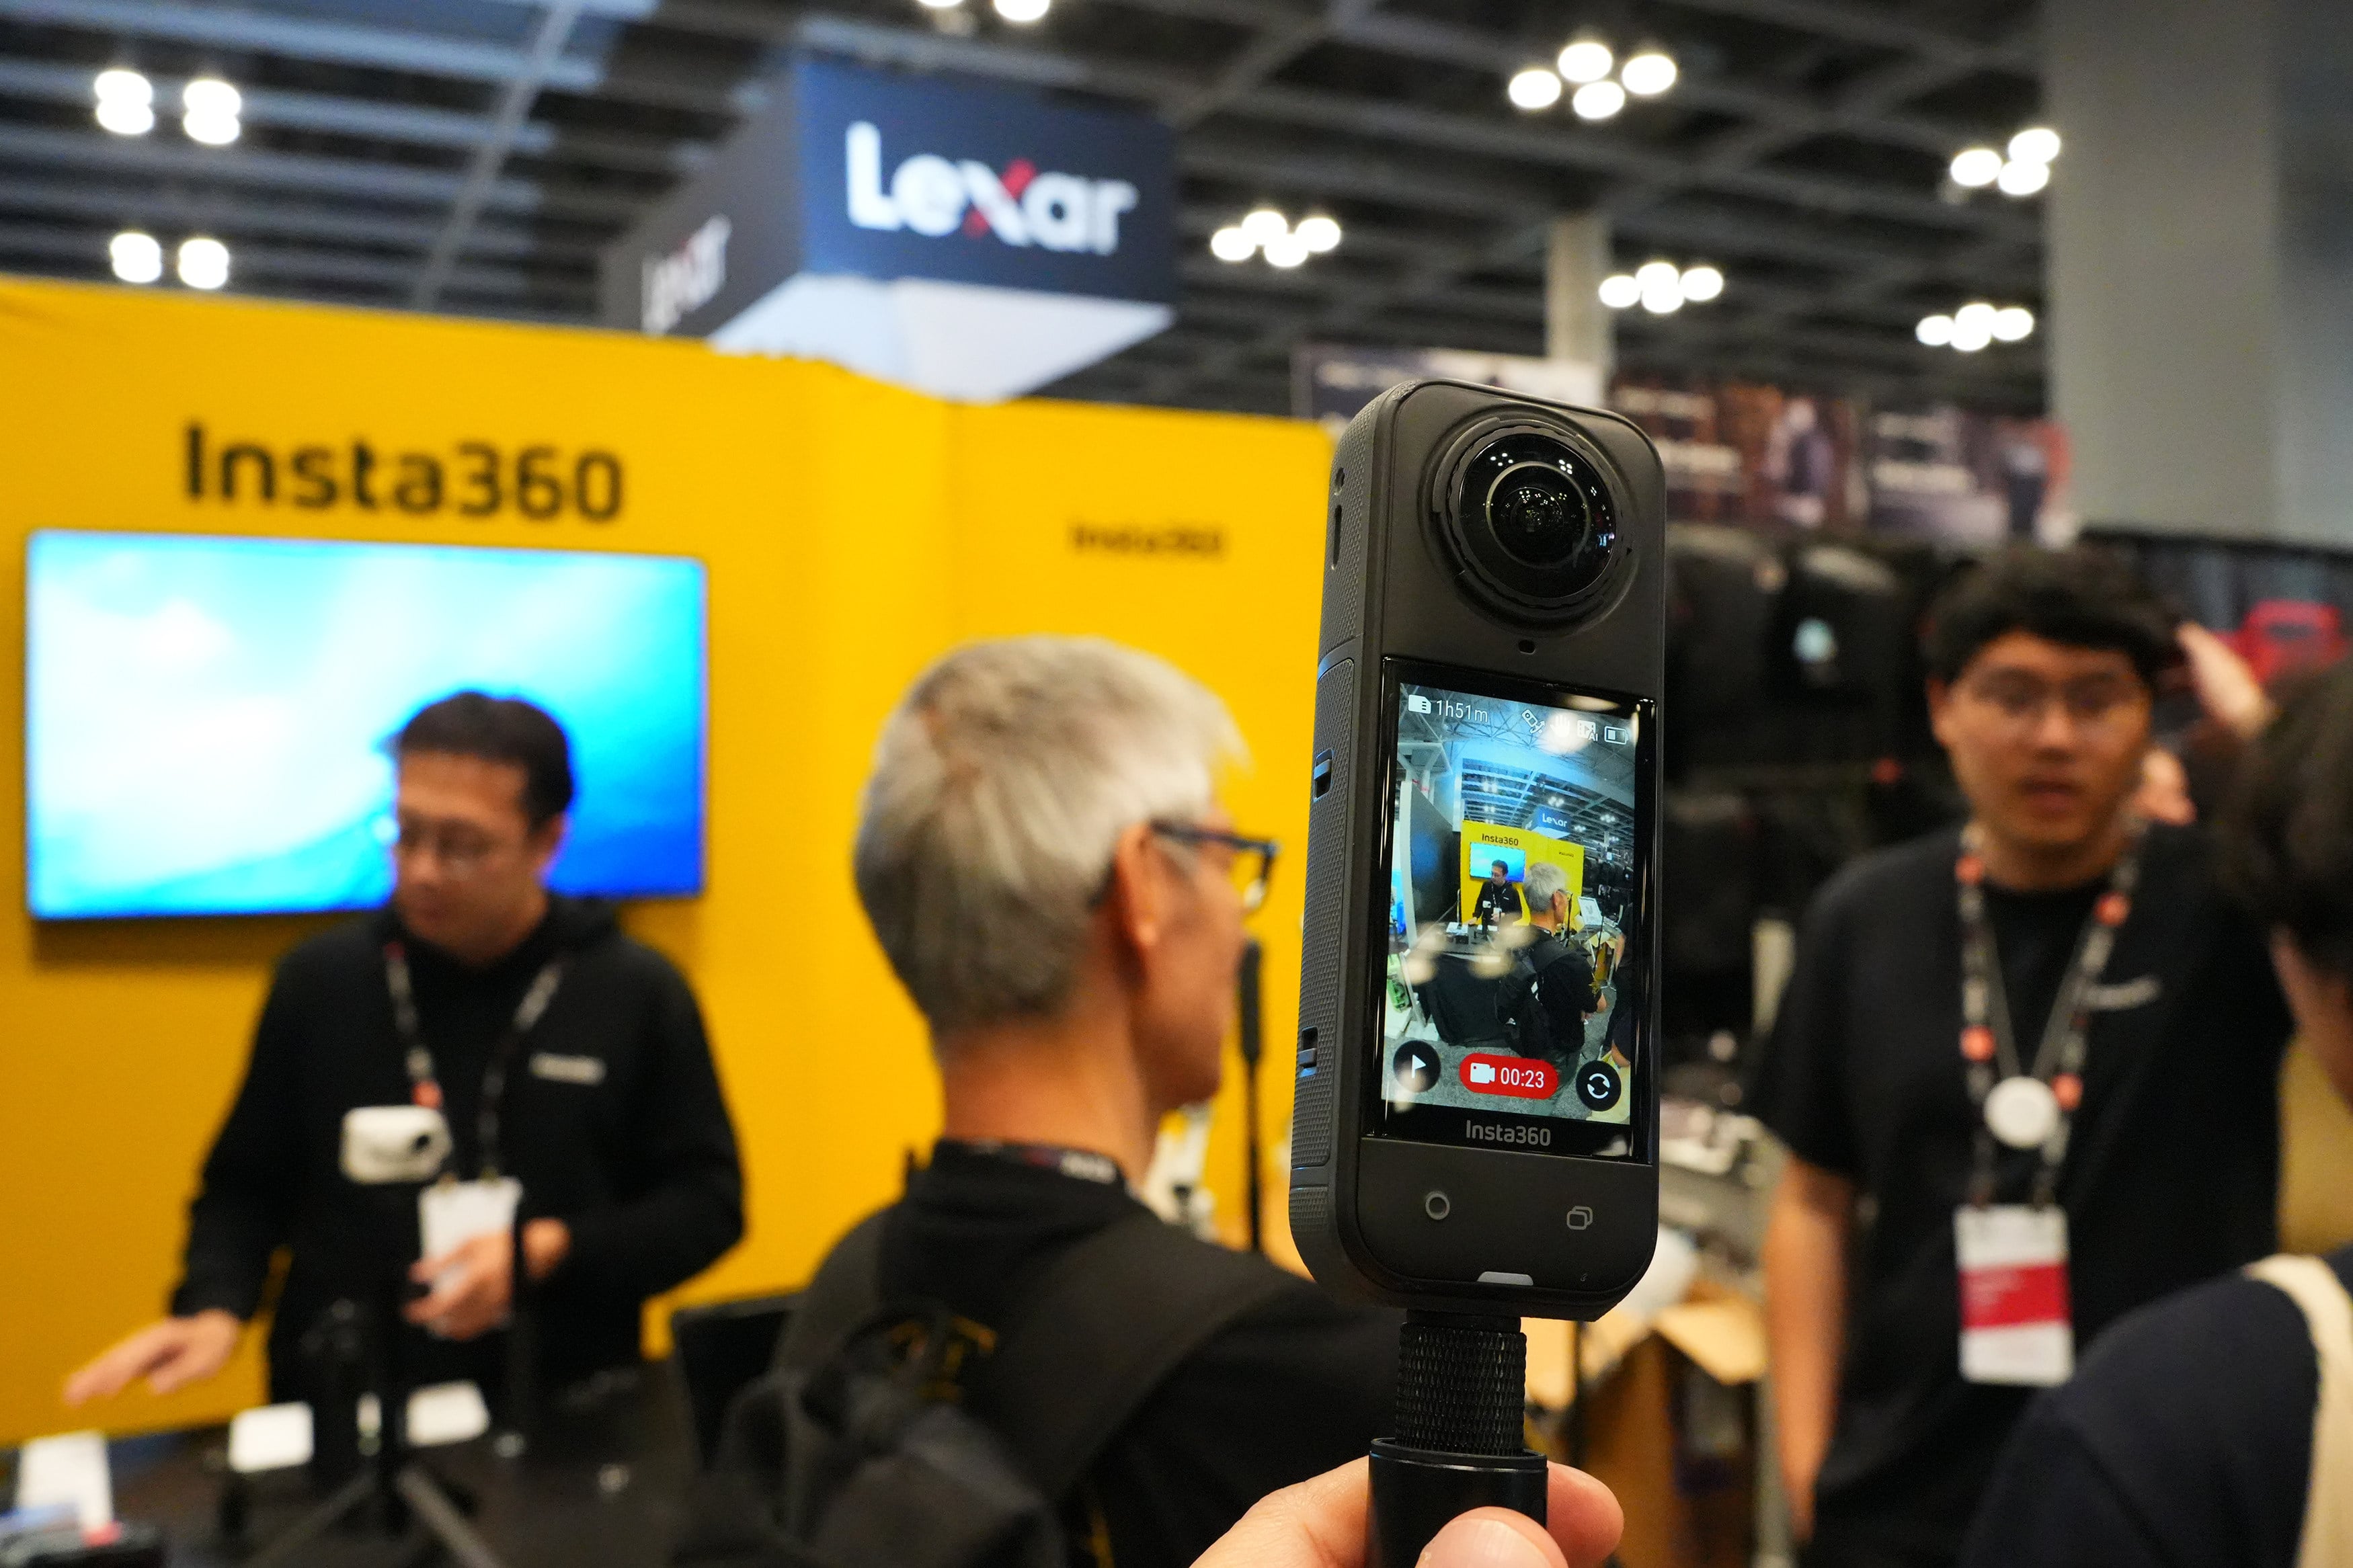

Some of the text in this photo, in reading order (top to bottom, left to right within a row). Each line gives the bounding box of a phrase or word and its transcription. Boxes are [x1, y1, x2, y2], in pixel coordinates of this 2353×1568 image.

[844, 121, 1139, 255] Lexar
[183, 422, 624, 524] Insta360
[1437, 700, 1488, 723] 1h51m
[1482, 833, 1519, 846] Insta360
[1501, 1067, 1544, 1088] 00:23
[1466, 1120, 1551, 1146] Insta360
